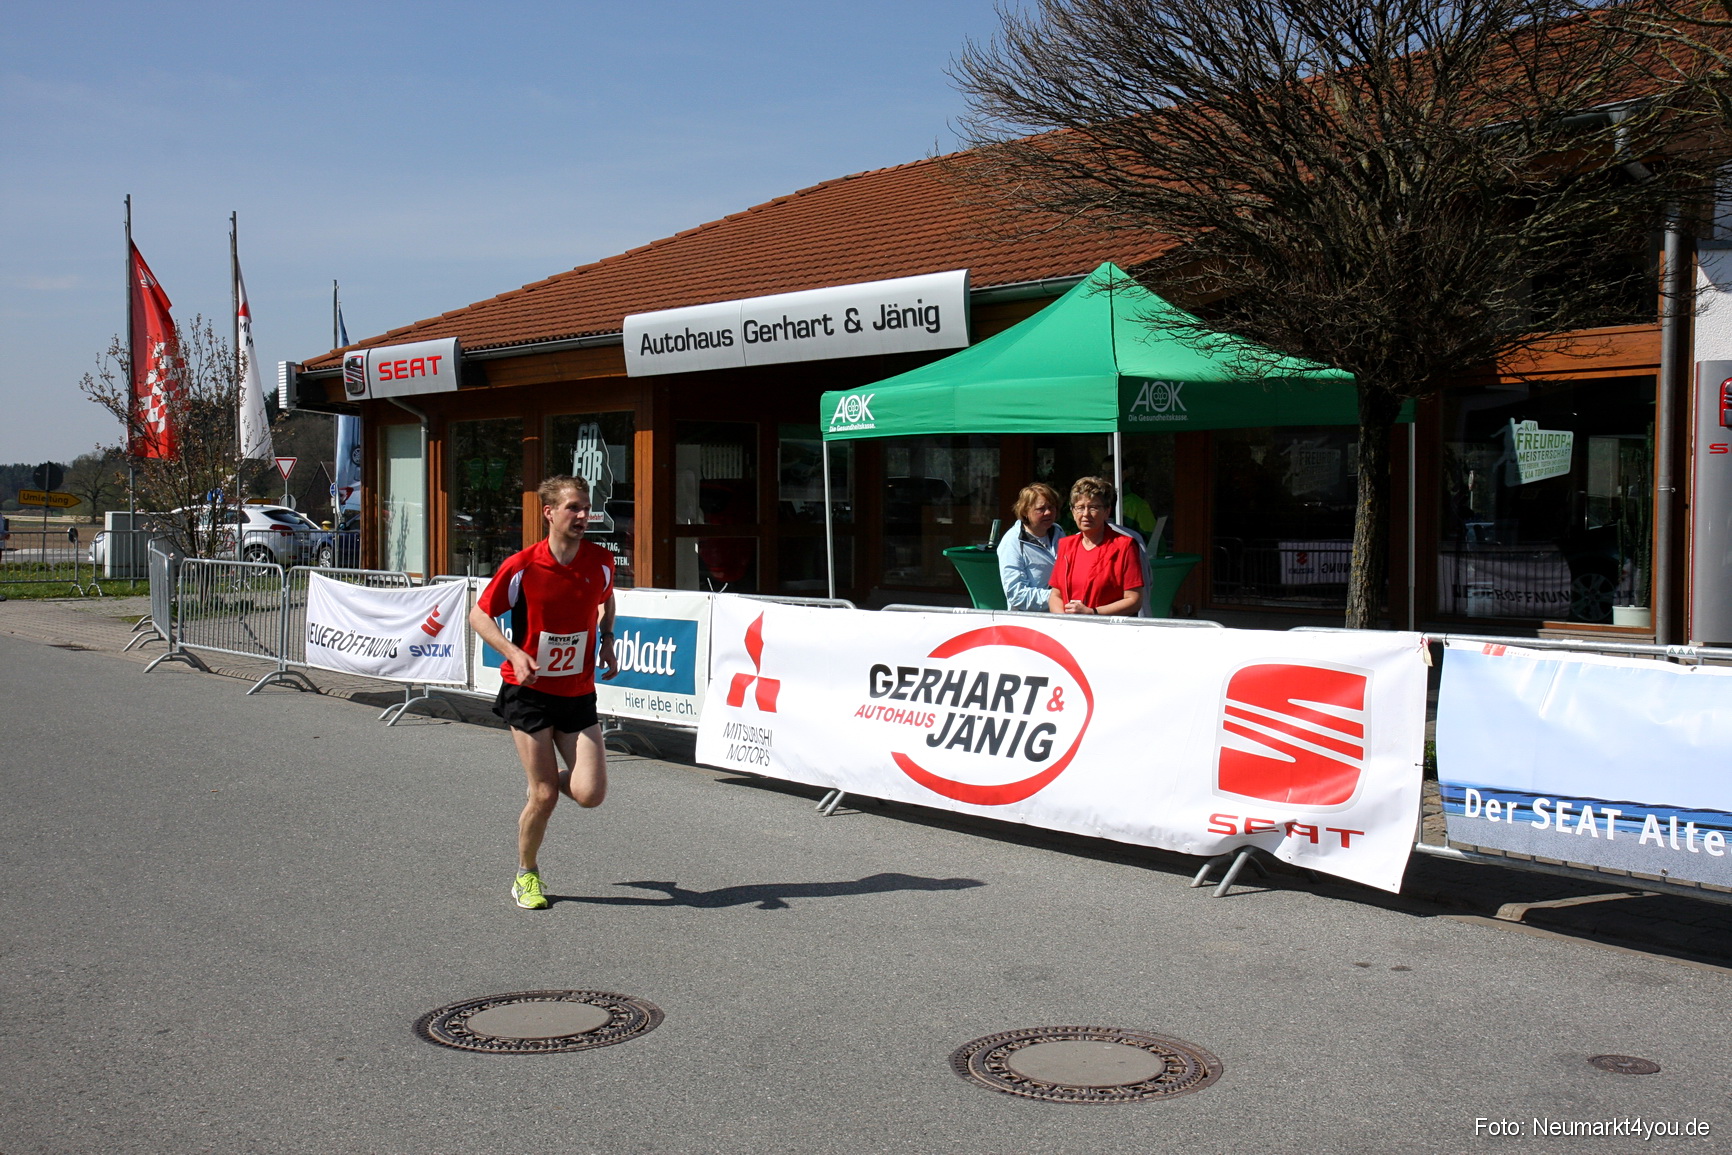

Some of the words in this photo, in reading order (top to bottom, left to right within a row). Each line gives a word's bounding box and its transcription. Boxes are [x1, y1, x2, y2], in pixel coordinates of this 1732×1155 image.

[640, 327, 734, 356] Autohaus
[743, 313, 835, 343] Gerhart
[844, 307, 864, 333] &
[873, 299, 941, 333] Jänig
[378, 355, 442, 381] SEAT
[830, 393, 876, 424] AOK
[1130, 381, 1187, 412] AOK
[1138, 413, 1189, 422] Gesundheitskasse.
[1524, 422, 1537, 432] KIA
[577, 423, 599, 452] GO
[1516, 432, 1571, 450] FREUROPA
[572, 450, 603, 481] FOR
[1518, 448, 1571, 462] MEISTERSCHAFT
[22, 492, 69, 505] Umletung
[409, 644, 455, 657] SUZUKI
[547, 646, 576, 671] 22
[869, 663, 1049, 716] GERHART
[1046, 686, 1065, 713] &
[624, 692, 645, 710] Hier
[648, 695, 672, 712] lebe
[675, 697, 697, 715] ich.
[854, 704, 937, 729] AUTOHAUS
[723, 721, 773, 747] MITSUBISHI
[926, 712, 1057, 763] JÄNIG
[726, 743, 770, 767] MOTORS
[1207, 813, 1364, 849] SEAT
[1465, 788, 1517, 824] Der
[1531, 798, 1622, 841] SEAT
[1638, 813, 1732, 857] Alte
